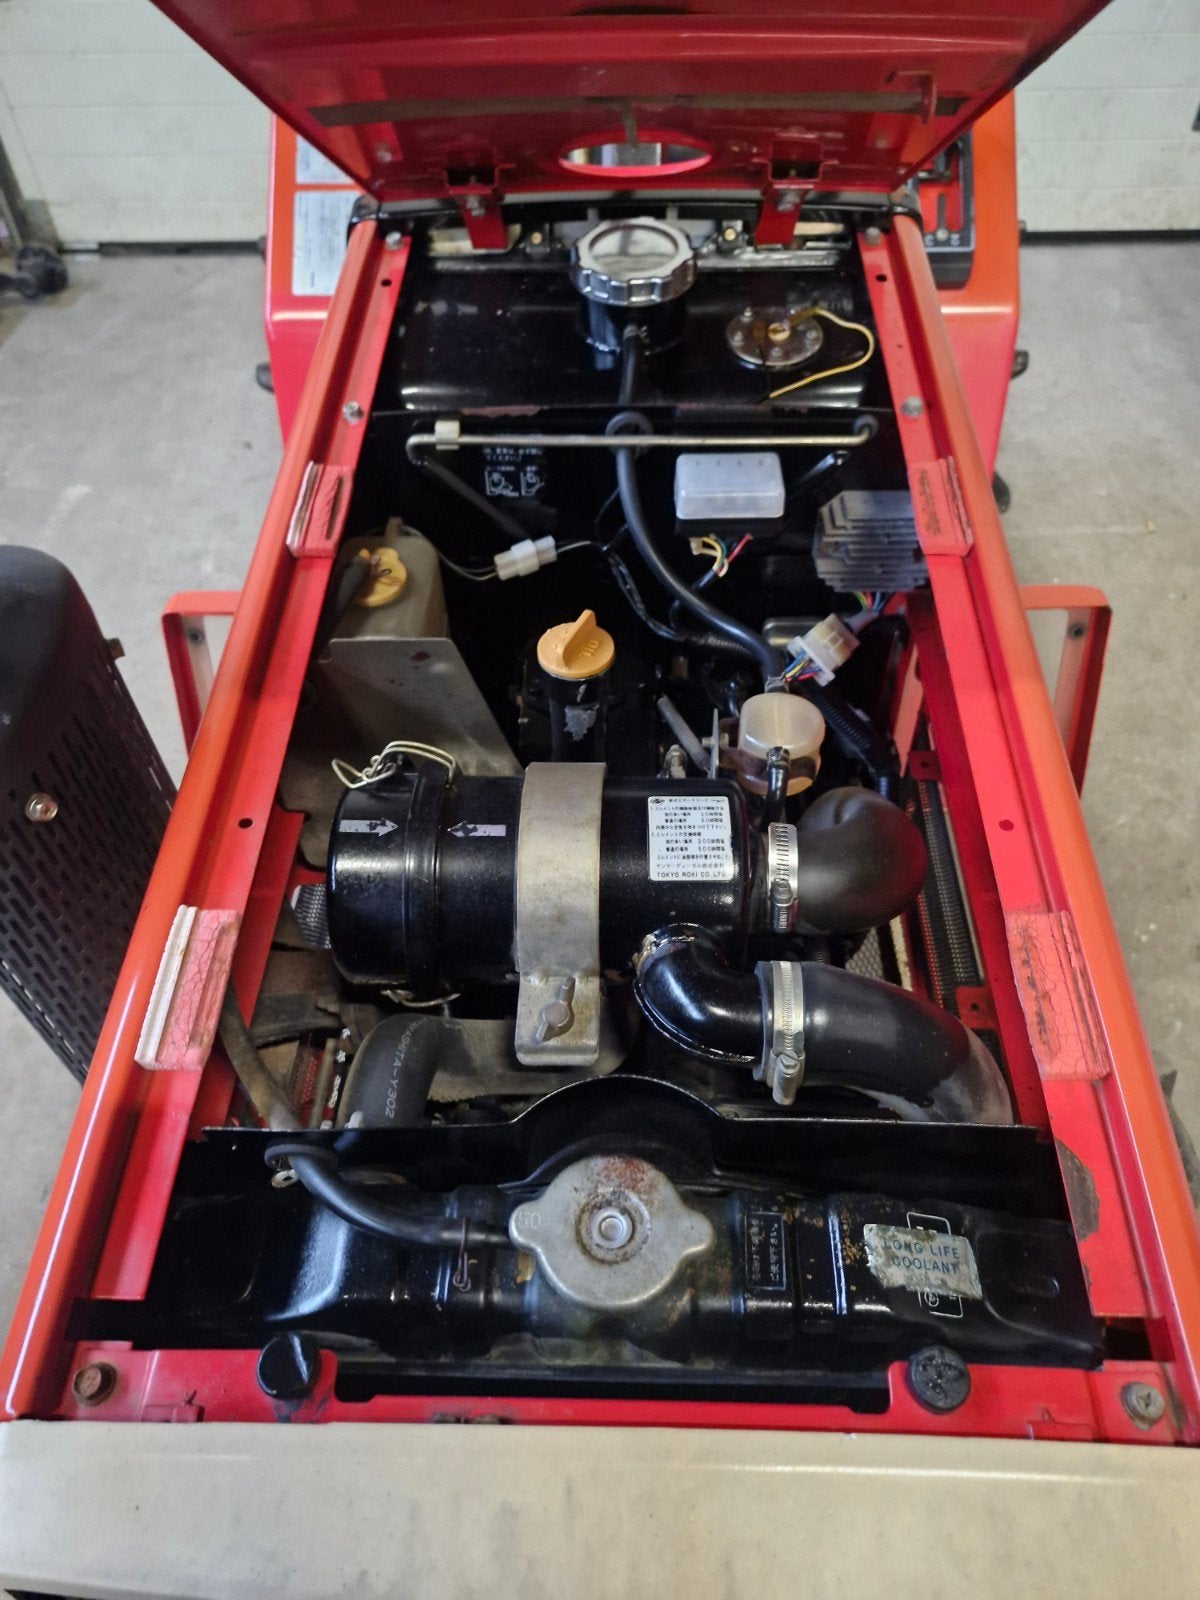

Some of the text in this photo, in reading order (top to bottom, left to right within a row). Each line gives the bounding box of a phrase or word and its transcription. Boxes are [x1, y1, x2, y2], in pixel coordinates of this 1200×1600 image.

[883, 1238, 960, 1259] LONG LIFE
[892, 1255, 960, 1274] COOLANT
